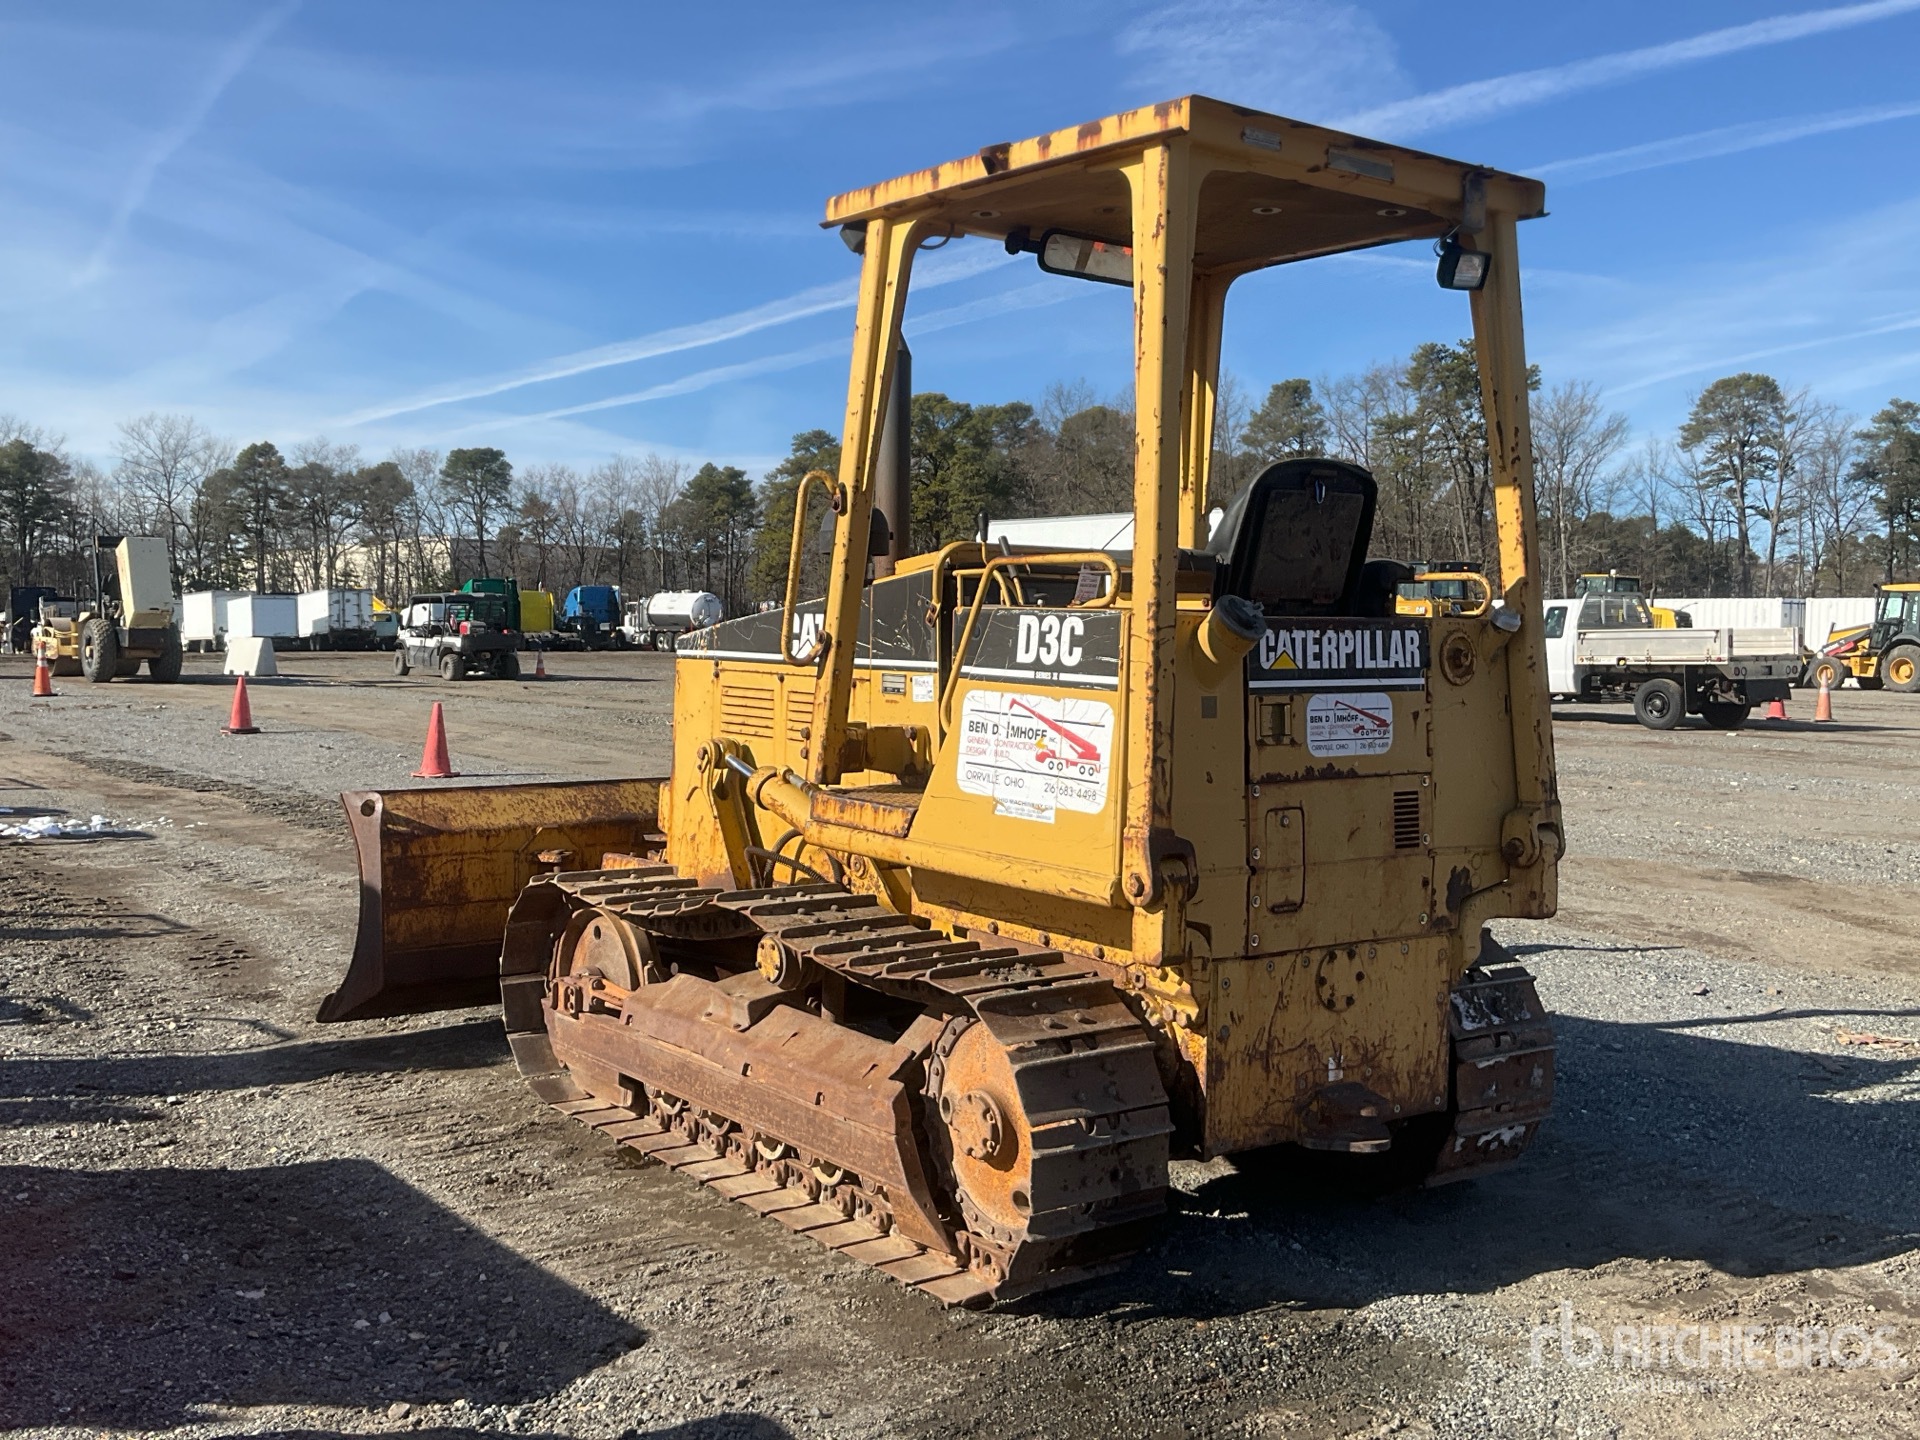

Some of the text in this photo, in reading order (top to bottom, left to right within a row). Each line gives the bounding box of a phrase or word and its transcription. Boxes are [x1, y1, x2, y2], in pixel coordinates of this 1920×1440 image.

[1016, 615, 1084, 666] D3C
[1260, 629, 1421, 669] CATERPILLAR
[968, 720, 988, 734] BEN
[1310, 715, 1323, 723] BEN
[967, 735, 1037, 752] GENERAL CONTRACTORS
[966, 770, 999, 785] ORRVILLE
[1004, 776, 1025, 788] OHIO
